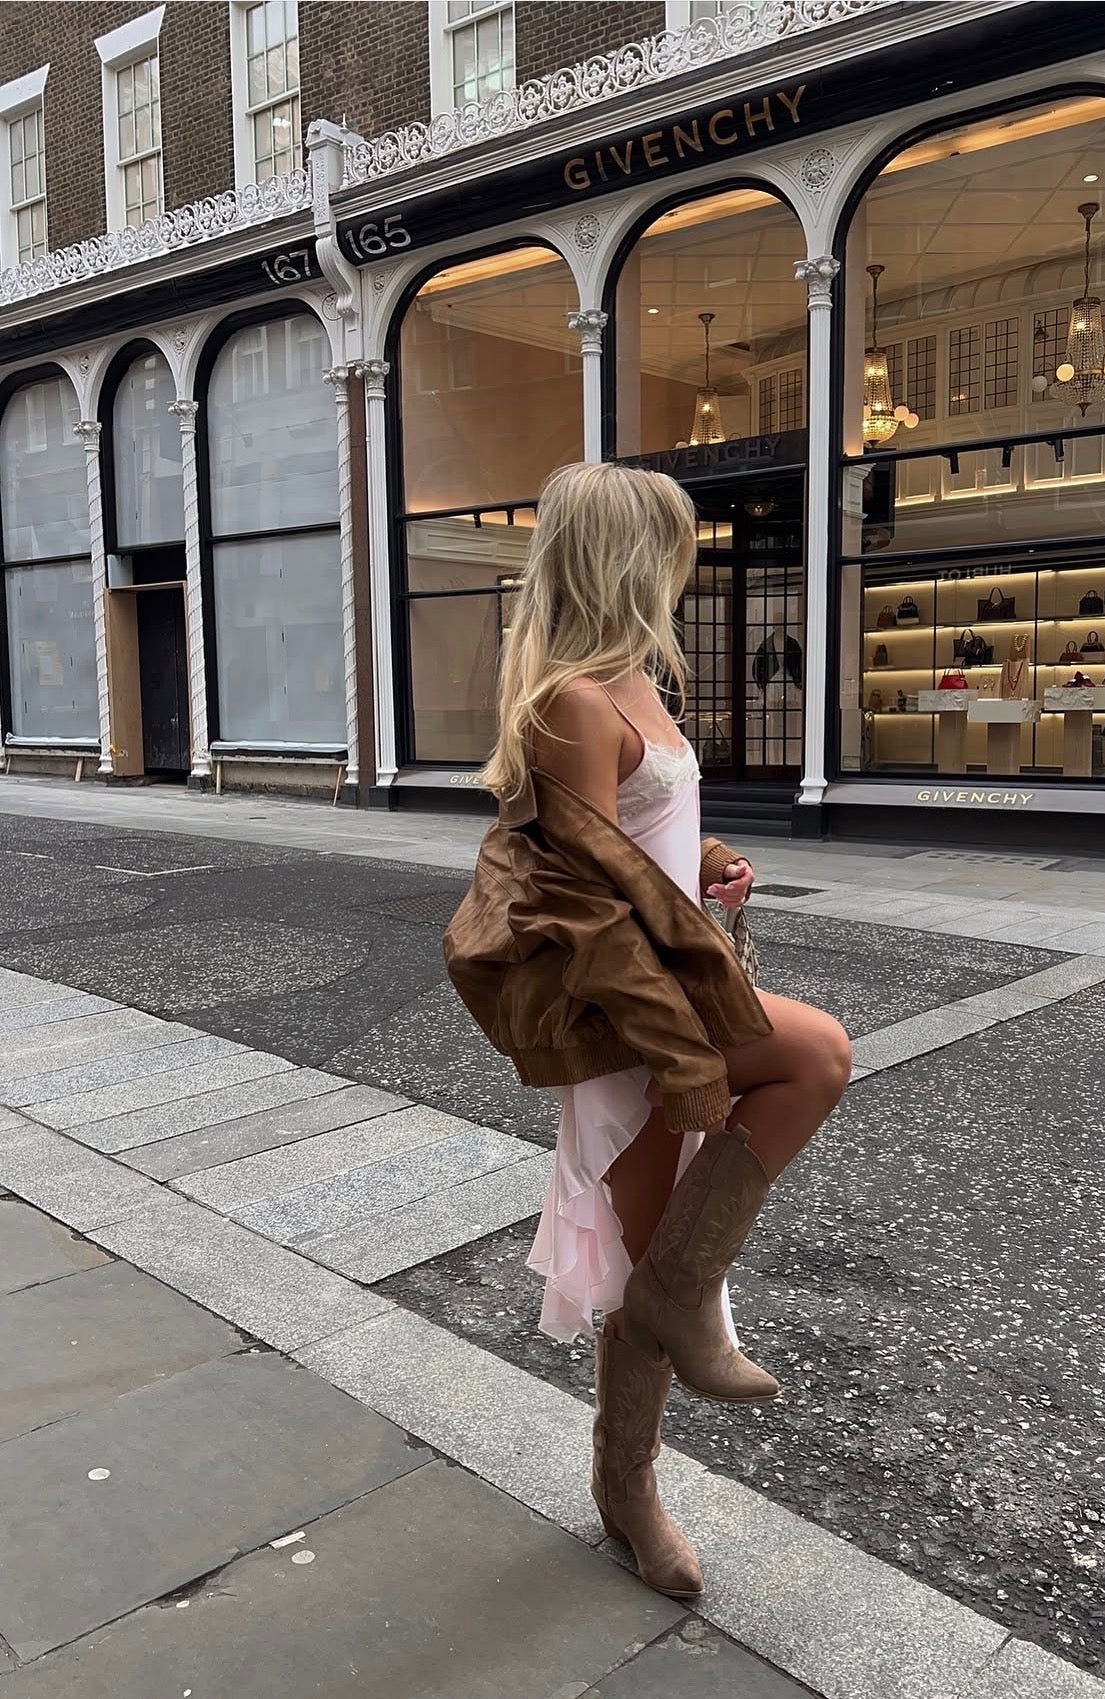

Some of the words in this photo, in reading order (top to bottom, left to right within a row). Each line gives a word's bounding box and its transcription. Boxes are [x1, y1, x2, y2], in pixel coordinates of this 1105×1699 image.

[564, 85, 806, 190] GIVENCHY
[345, 214, 411, 259] 165
[261, 249, 311, 284] 167
[917, 791, 1033, 805] GIVENCHY
